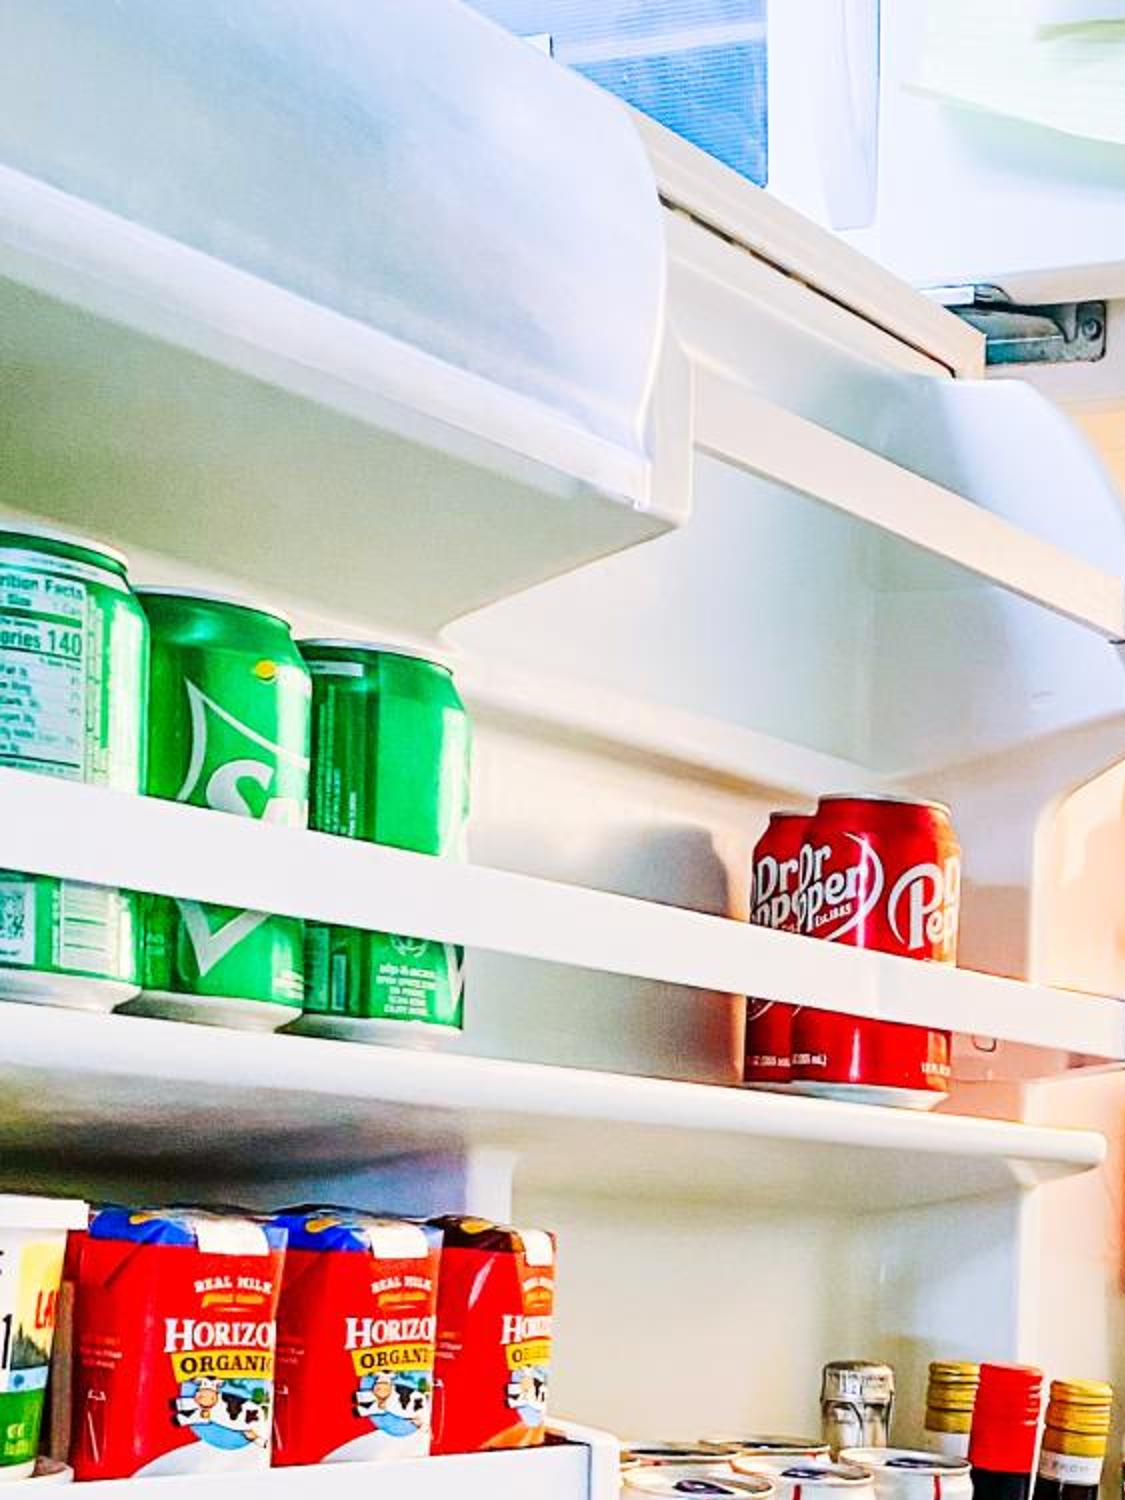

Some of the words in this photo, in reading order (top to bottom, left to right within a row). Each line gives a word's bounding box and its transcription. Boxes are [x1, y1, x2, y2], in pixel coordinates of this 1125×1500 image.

[44, 578, 83, 599] Facts
[47, 628, 82, 658] 140
[195, 1275, 233, 1293] REAL
[237, 1276, 273, 1295] MILK
[371, 1276, 403, 1294] REAL
